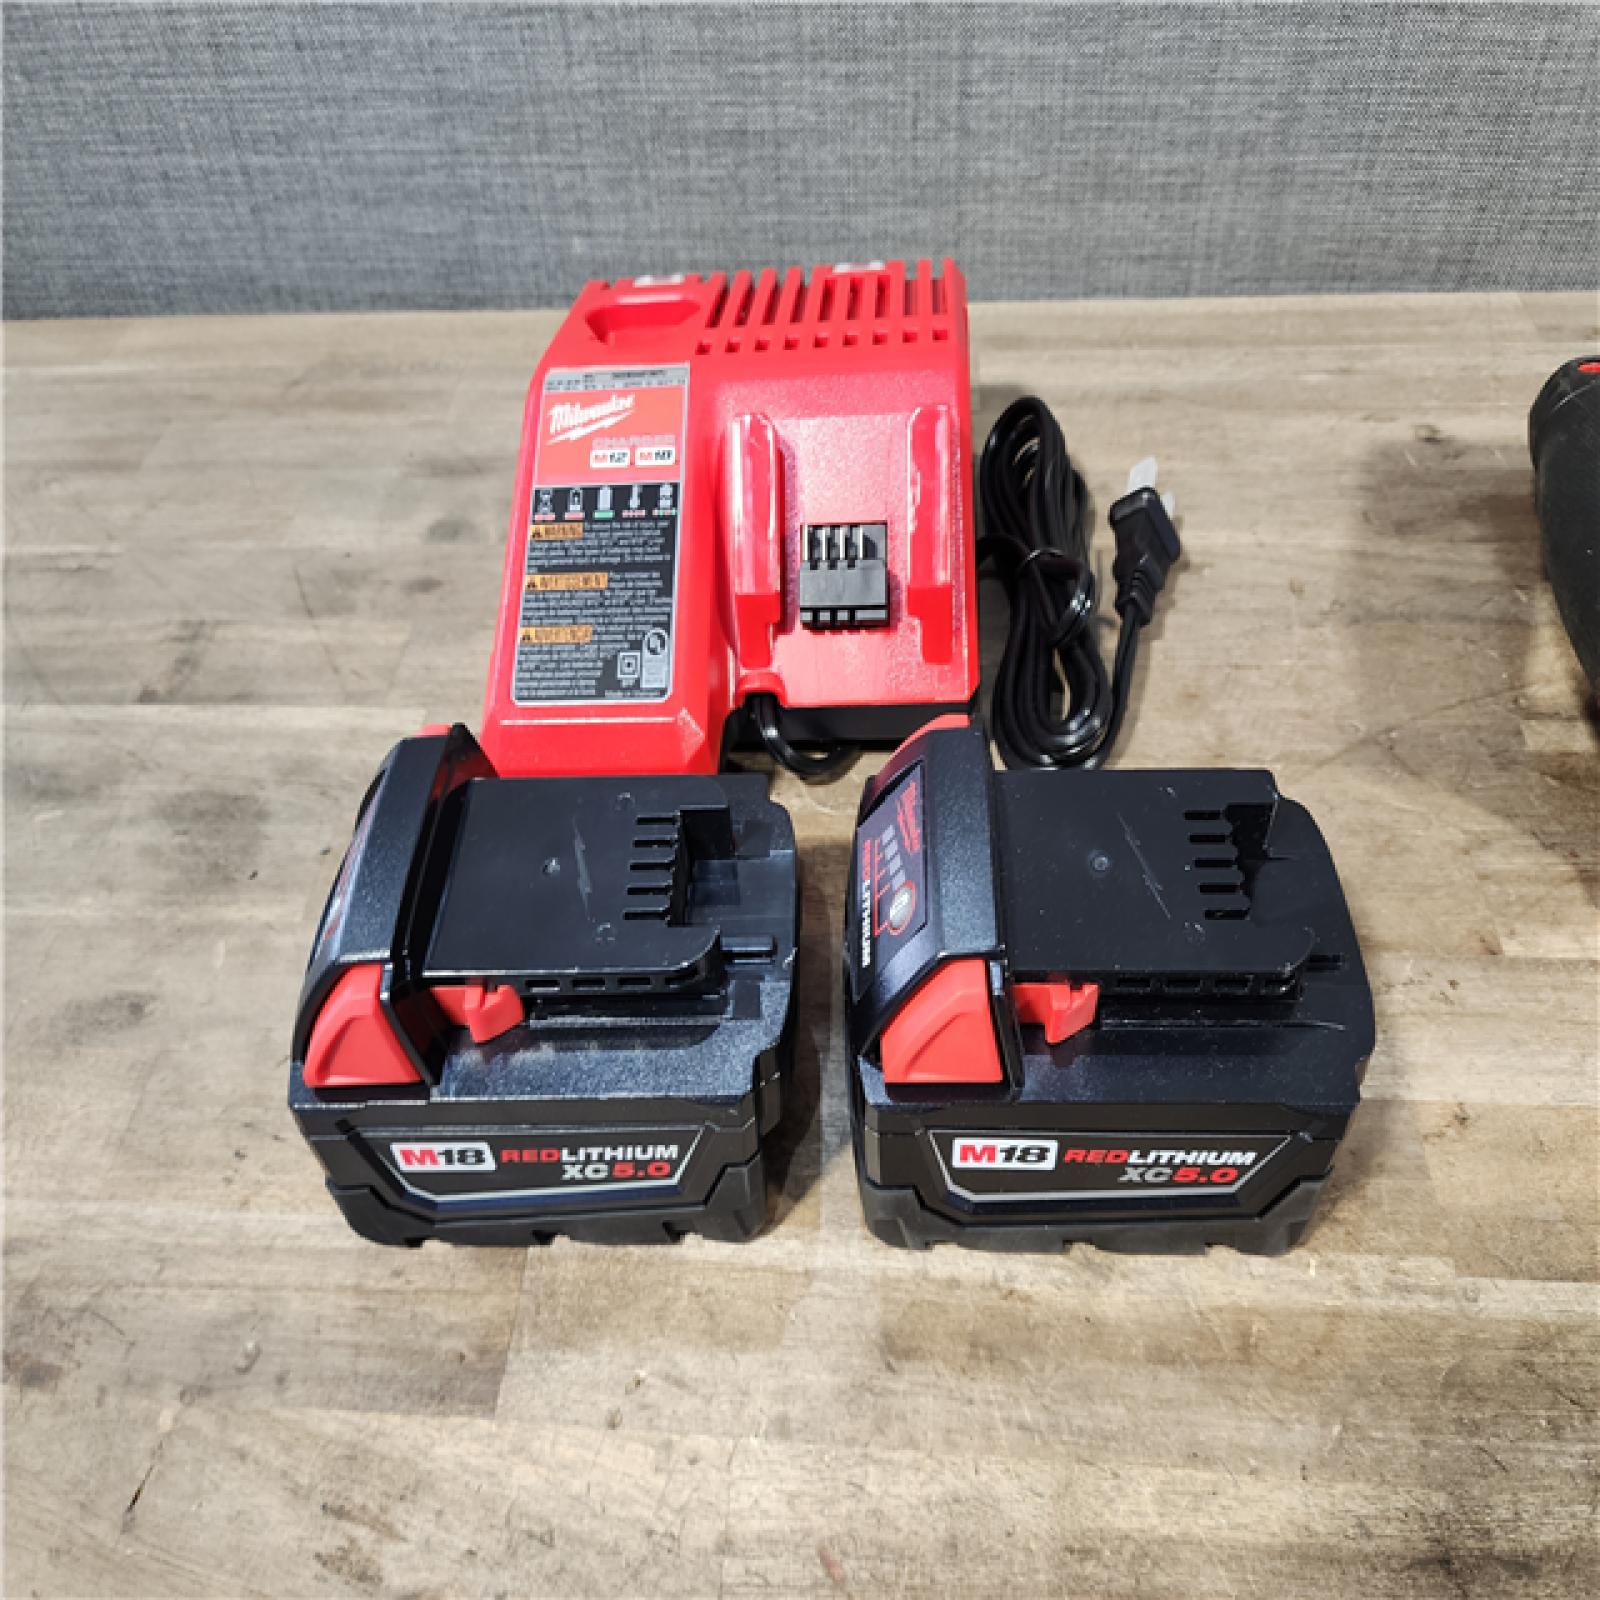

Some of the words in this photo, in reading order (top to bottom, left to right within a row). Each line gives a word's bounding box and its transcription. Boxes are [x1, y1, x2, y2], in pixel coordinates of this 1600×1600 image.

[399, 1148, 486, 1166] M18
[500, 1144, 679, 1164] REDLITHIUM
[959, 1144, 1050, 1164] M18
[1063, 1148, 1257, 1166] REDLITHIUM
